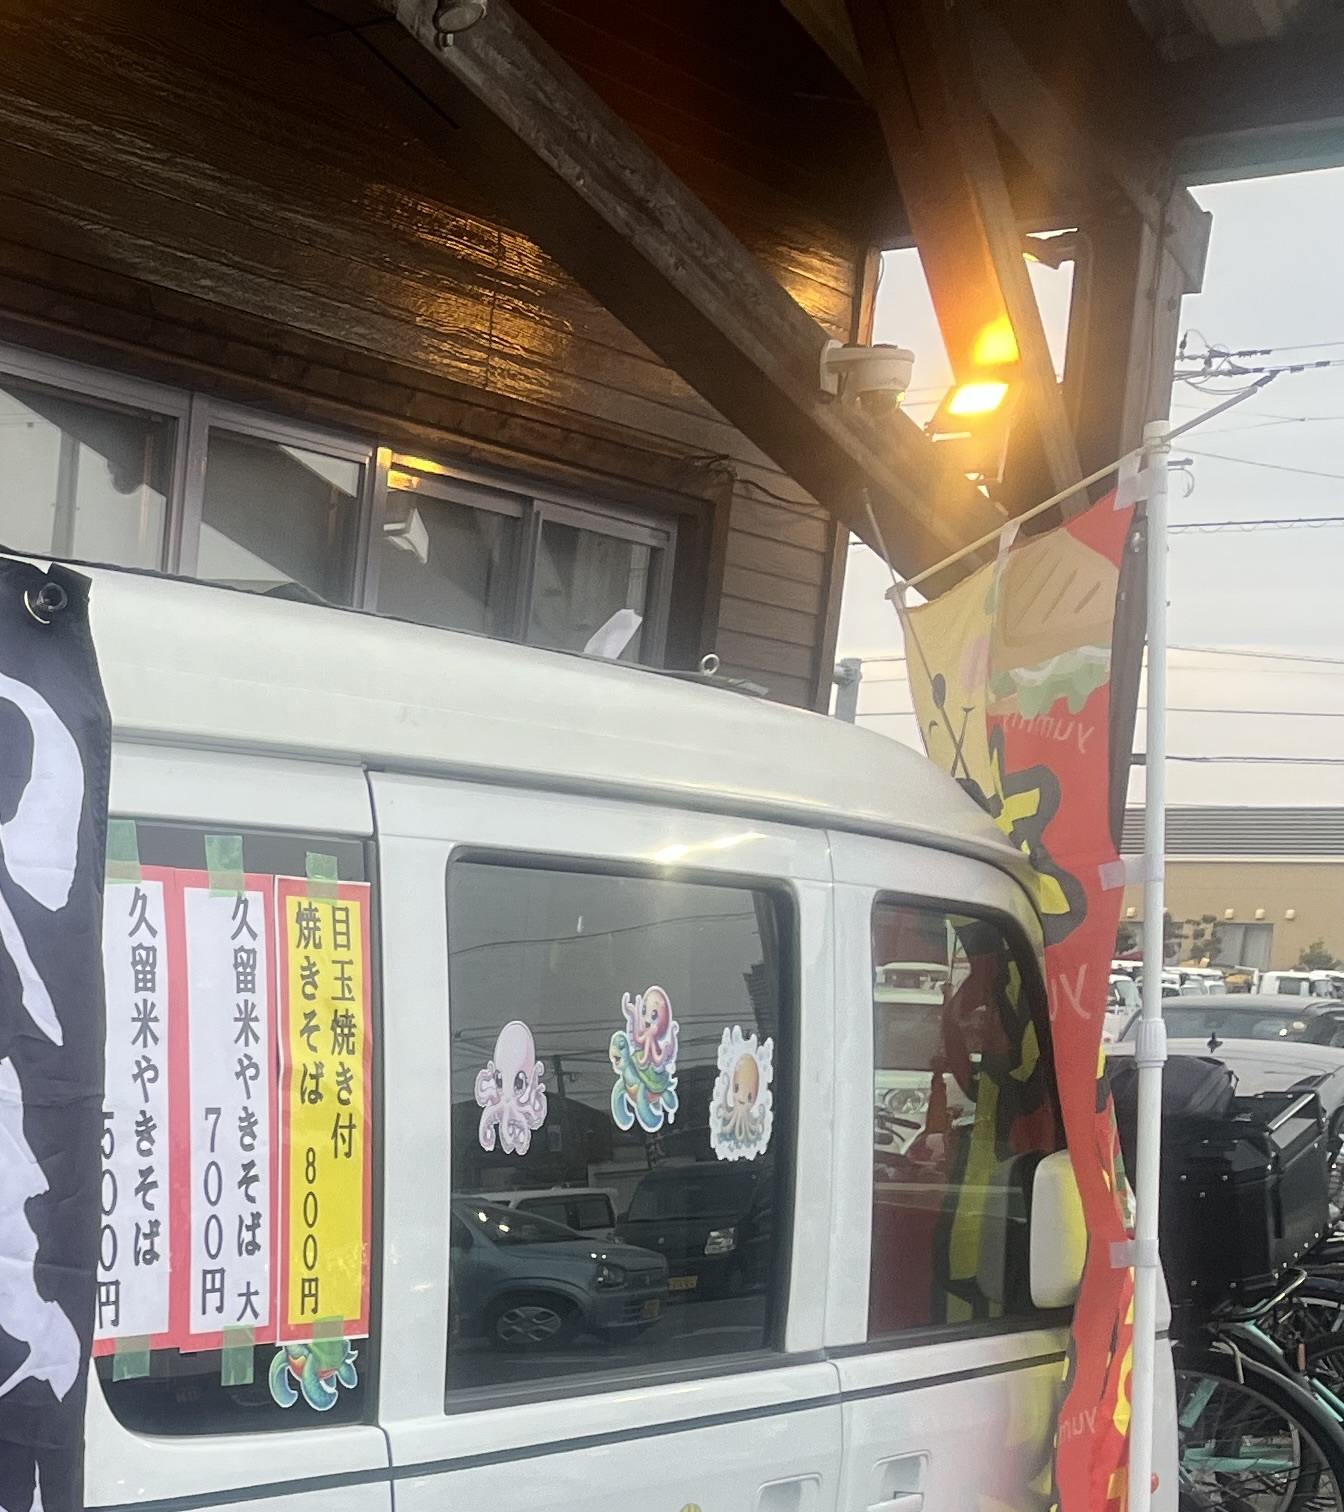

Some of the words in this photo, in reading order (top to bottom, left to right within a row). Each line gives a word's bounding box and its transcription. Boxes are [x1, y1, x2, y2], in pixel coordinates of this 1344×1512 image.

[127, 885, 162, 1267] 久留米やきそば
[230, 895, 262, 1258] 久留米やきそば
[295, 900, 324, 1106] 焼きそば
[329, 905, 358, 1161] 目玉焼き付
[200, 1106, 226, 1316] 700円
[300, 1146, 320, 1316] 800円
